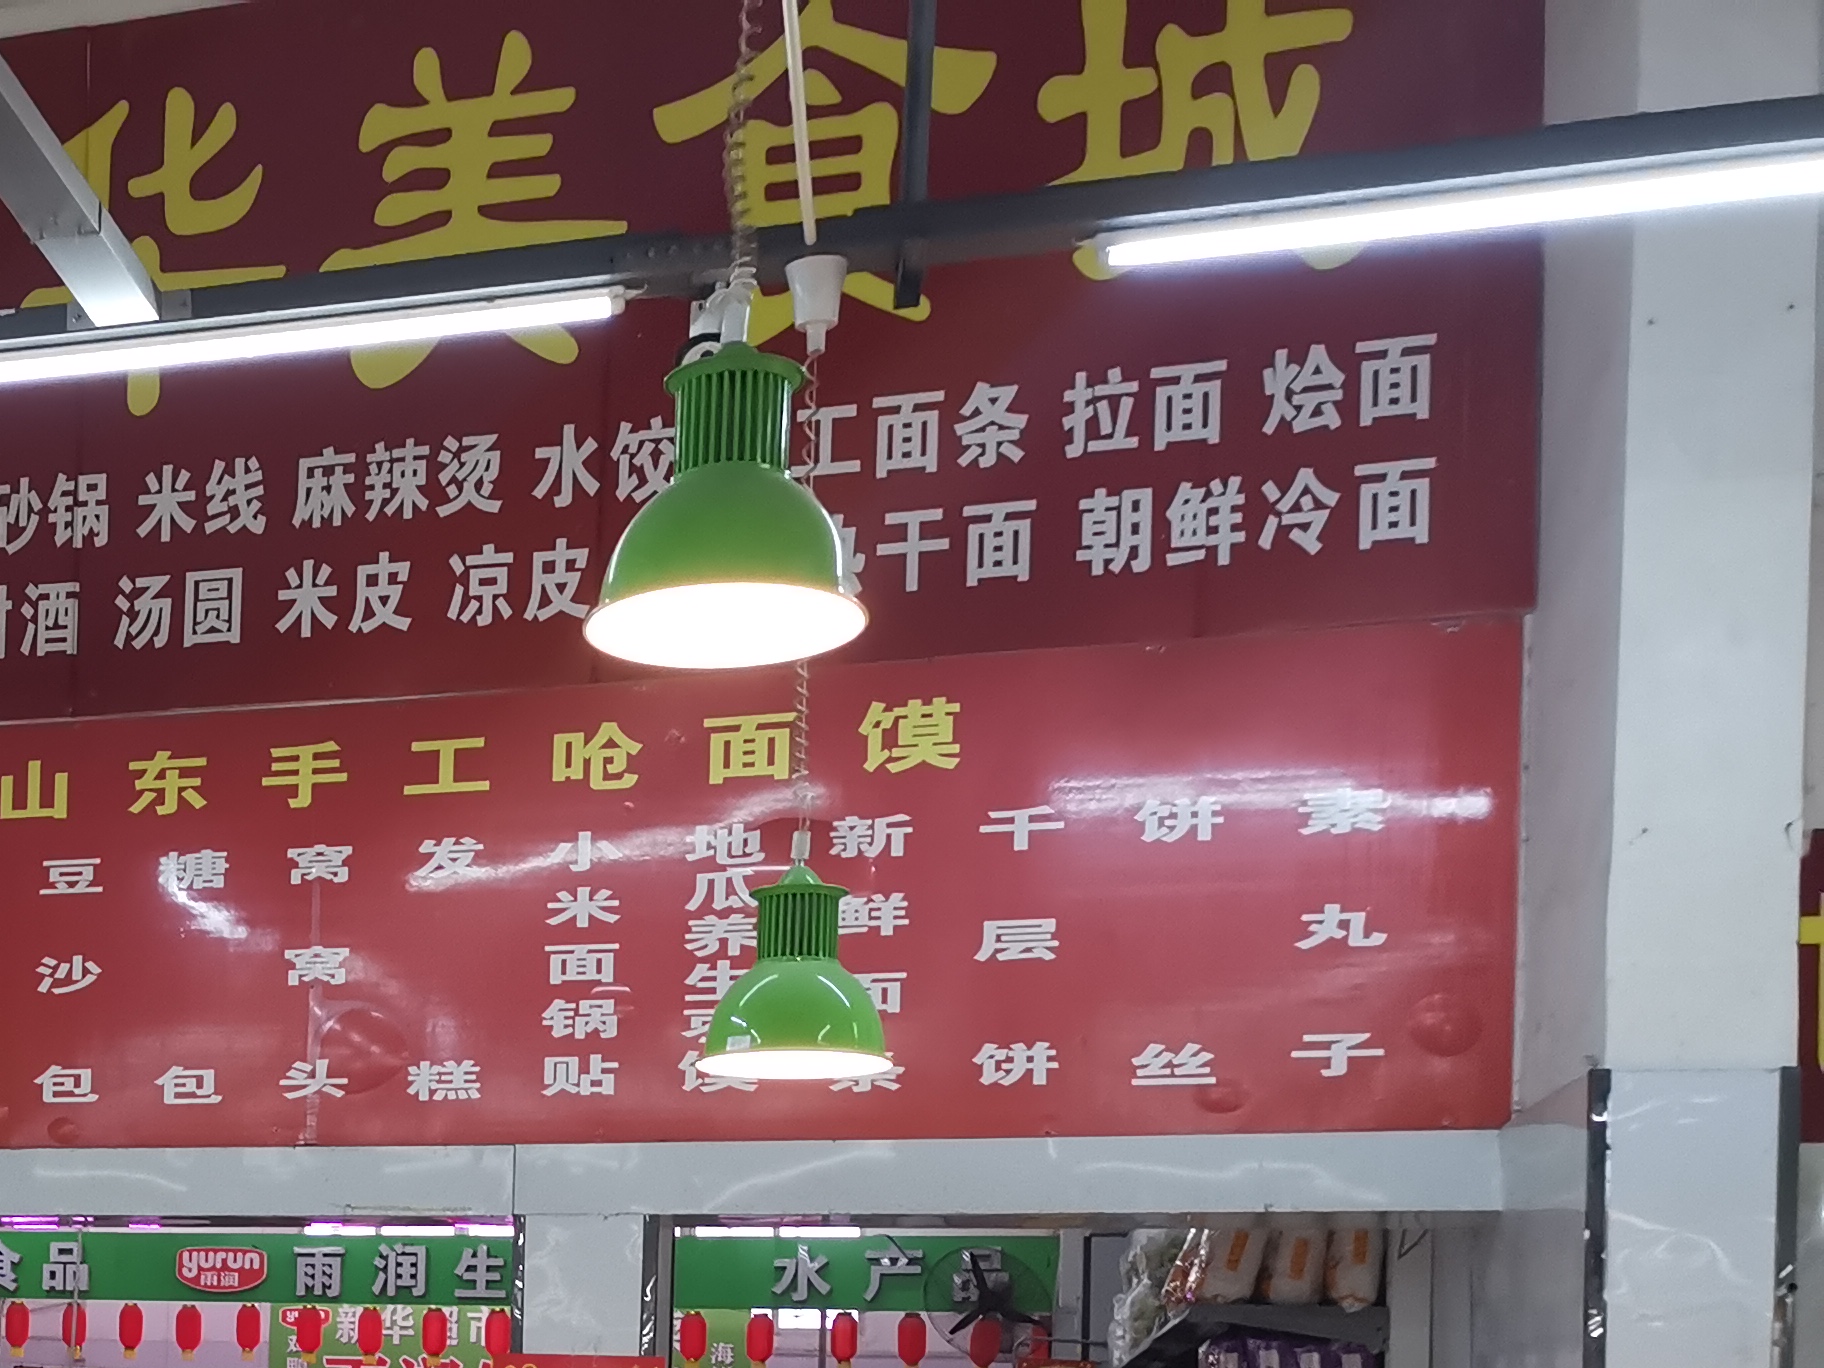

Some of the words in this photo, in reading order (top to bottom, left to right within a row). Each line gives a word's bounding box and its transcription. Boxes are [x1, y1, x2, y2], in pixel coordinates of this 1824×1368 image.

[113, 568, 244, 651] 汤圆
[275, 551, 413, 638] 米皮
[447, 538, 591, 627] 凉皮
[1076, 457, 1437, 576] 朝鲜冷面
[137, 458, 267, 541] 米线
[292, 434, 504, 529] 麻辣烫
[791, 381, 1029, 479] 工面条
[1063, 359, 1229, 459] 拉面
[1262, 332, 1437, 437] 烩面
[0, 696, 963, 820] 山东手工呛面馍
[34, 858, 104, 1105] 豆沙包
[279, 844, 353, 1100] 窝窝头
[542, 829, 621, 1097] 小米面锅贴
[972, 806, 1065, 1086] 千层饼
